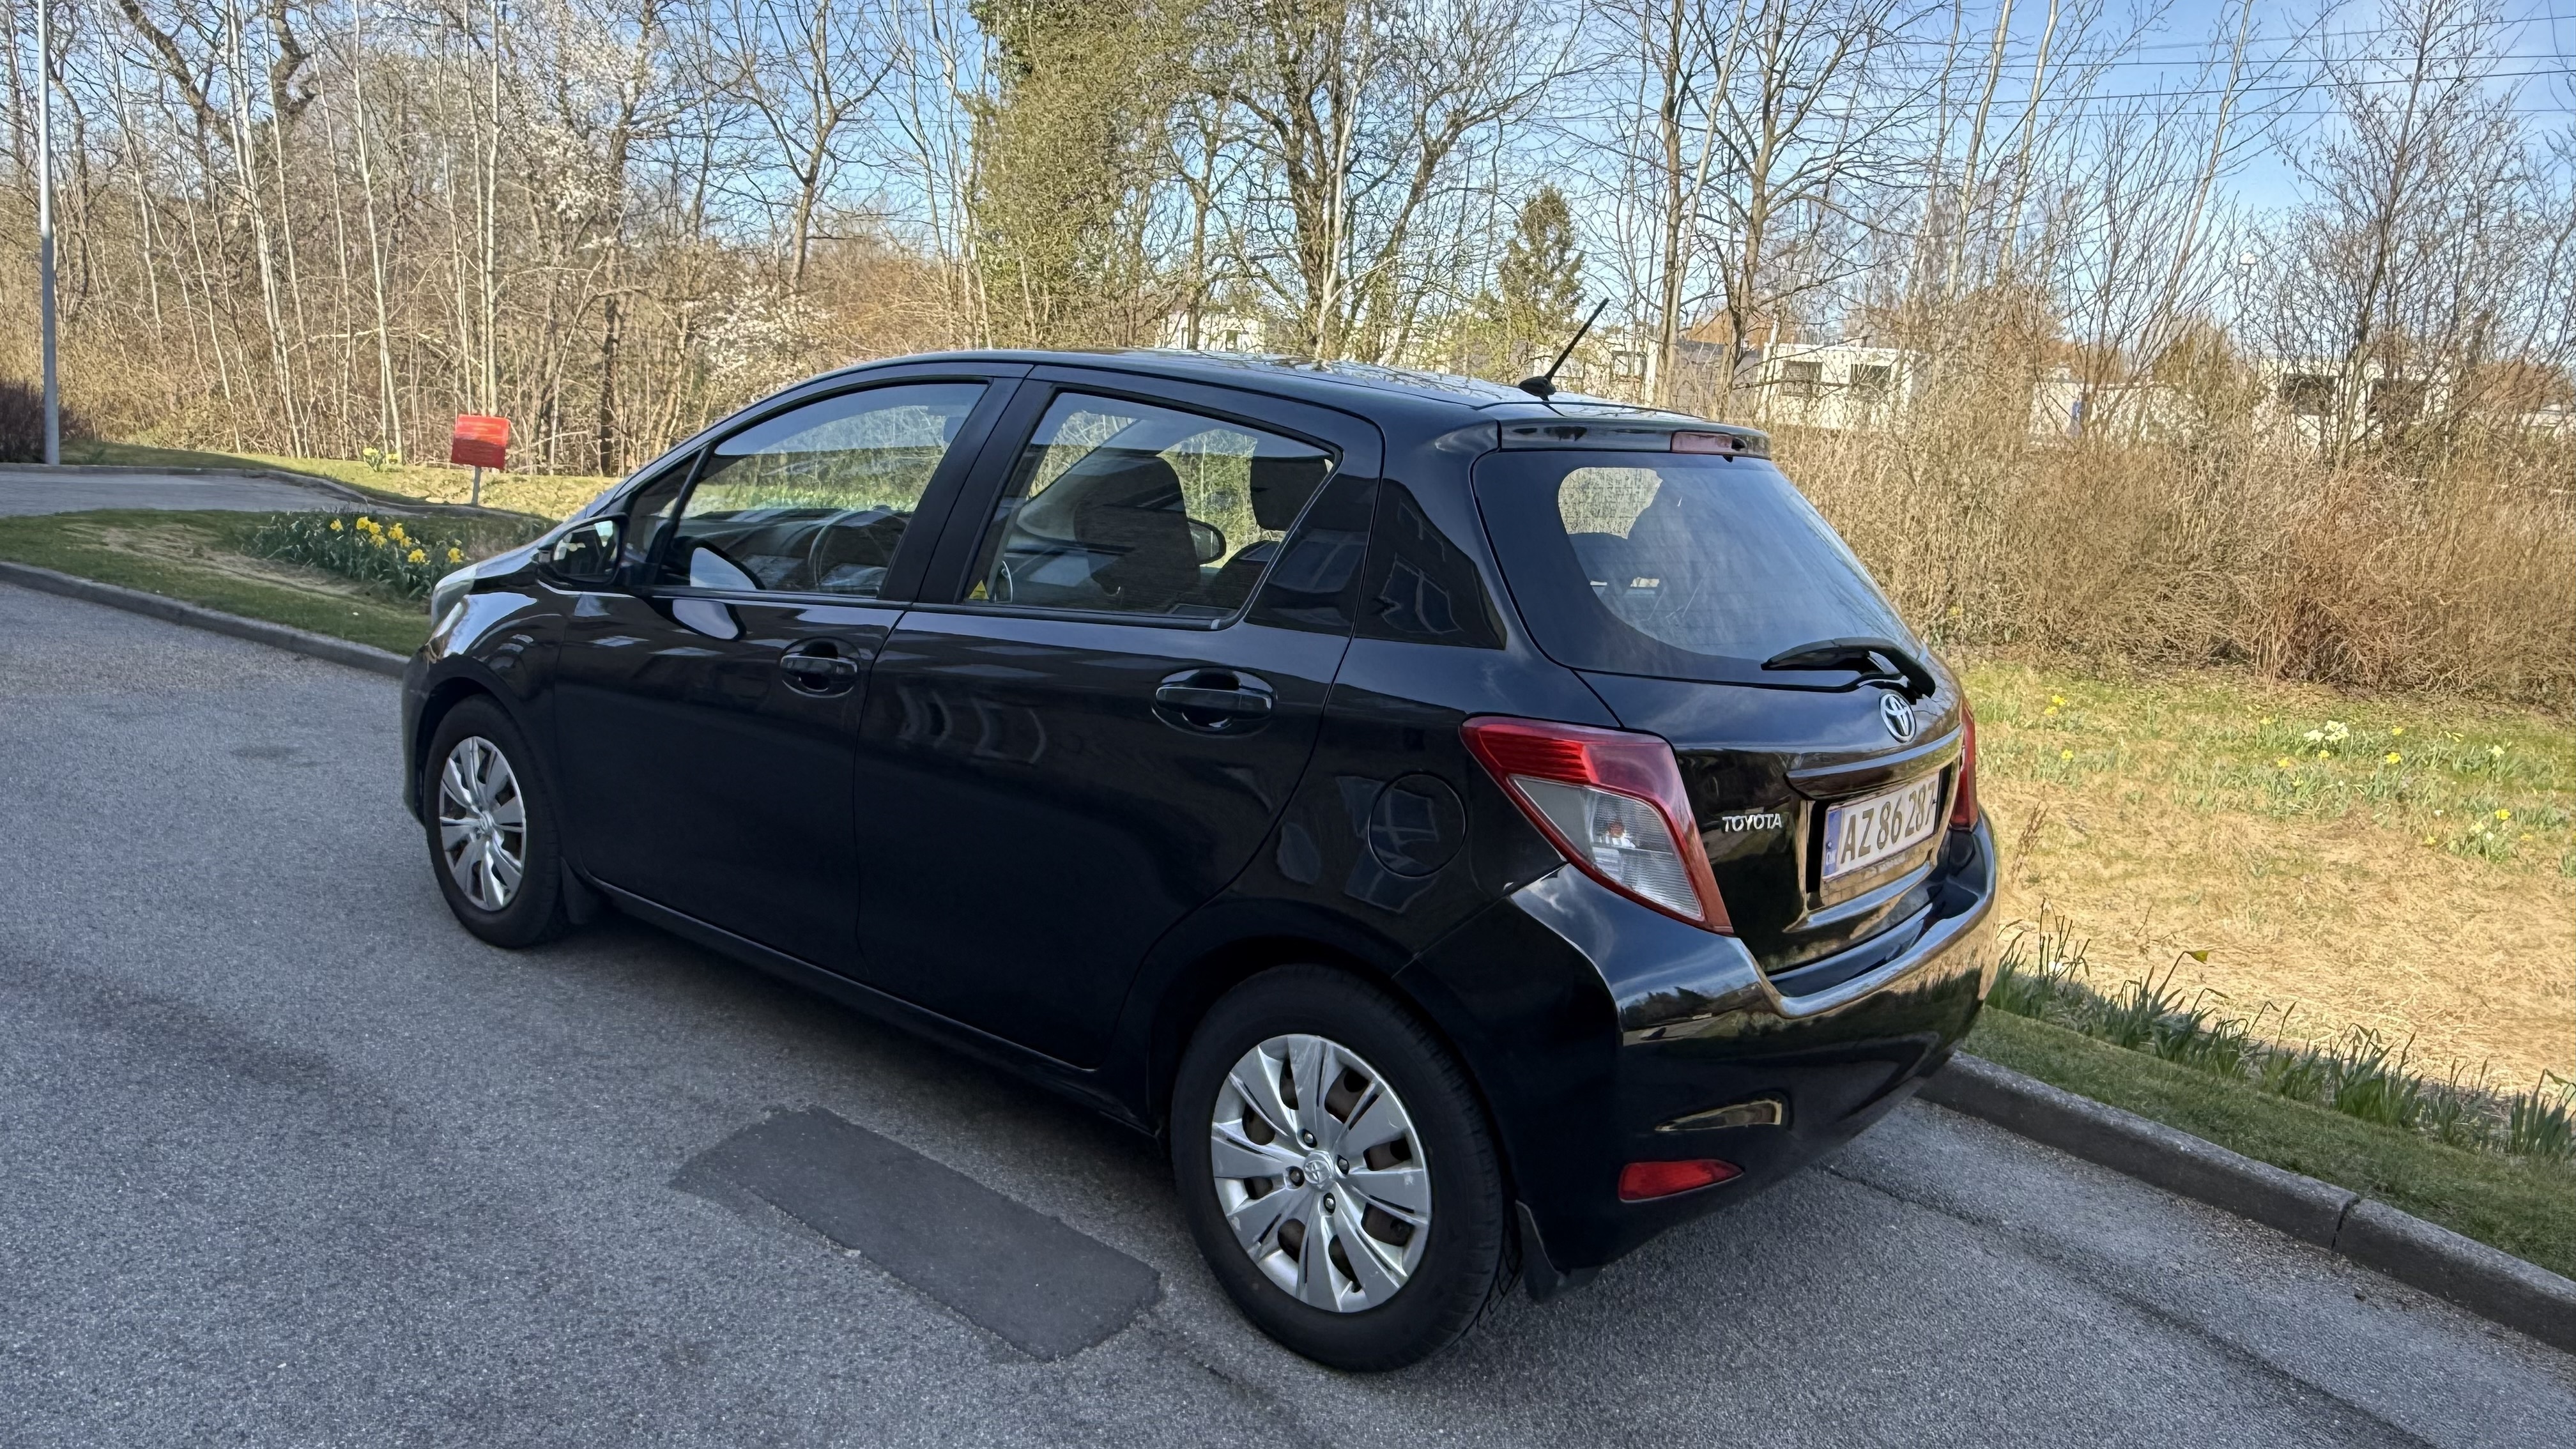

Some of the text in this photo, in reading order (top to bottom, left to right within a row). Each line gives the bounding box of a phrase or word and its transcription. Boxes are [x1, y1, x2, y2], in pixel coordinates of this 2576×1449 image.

[1722, 813, 1782, 832] TOYOTA
[1841, 781, 1936, 864] AZ 86 287
